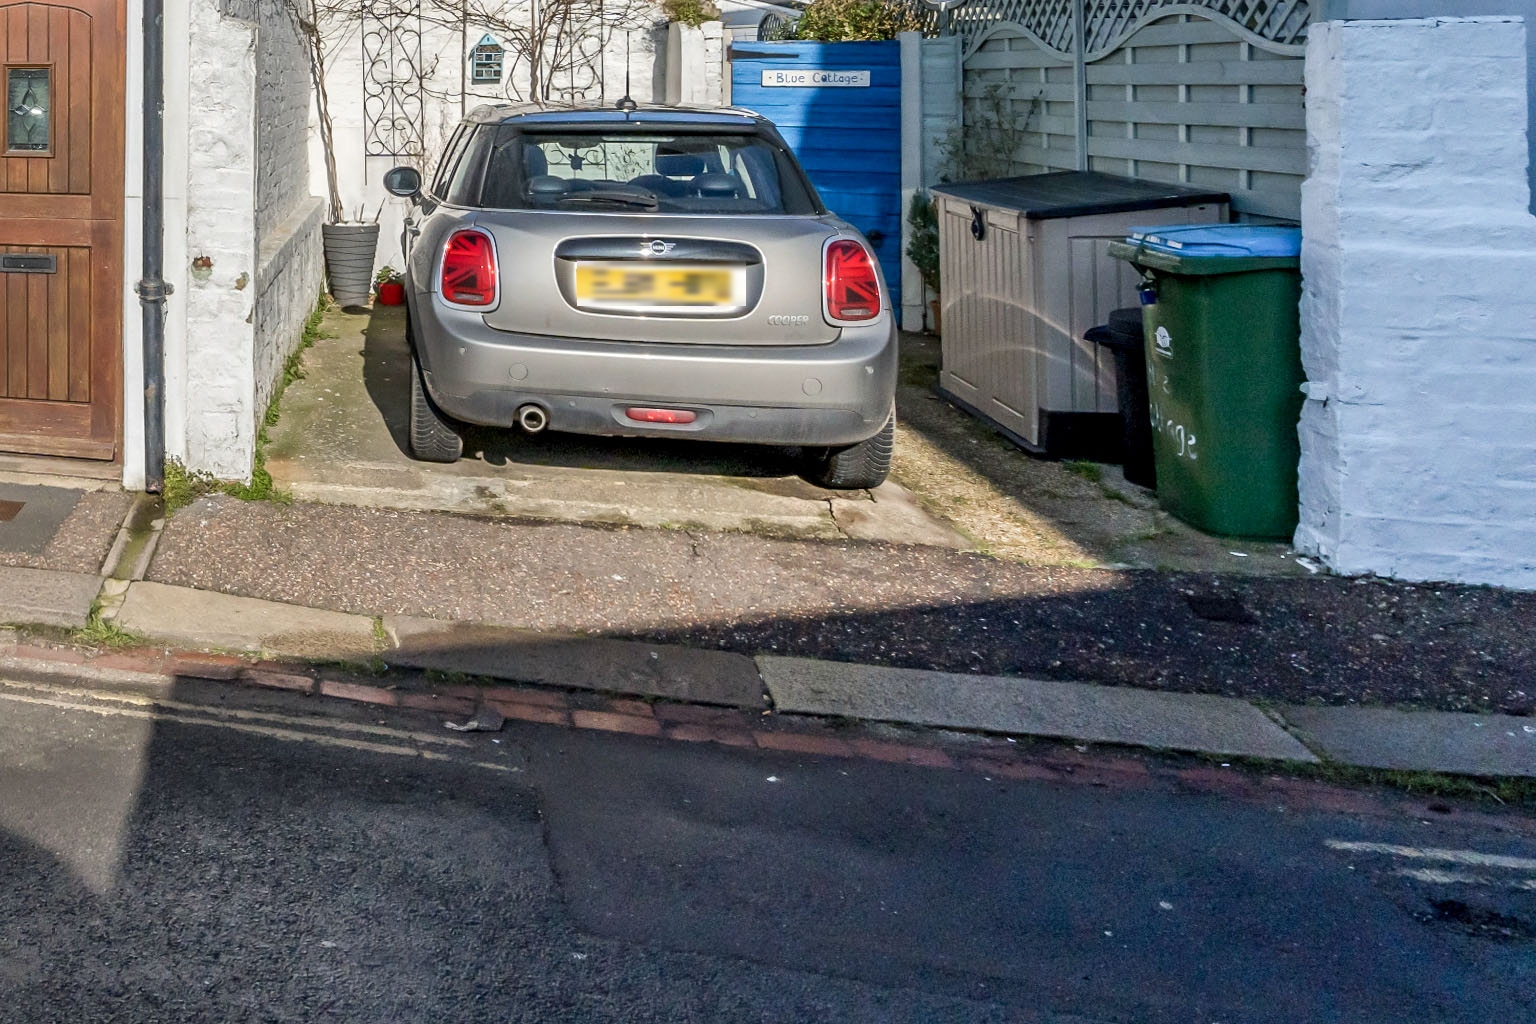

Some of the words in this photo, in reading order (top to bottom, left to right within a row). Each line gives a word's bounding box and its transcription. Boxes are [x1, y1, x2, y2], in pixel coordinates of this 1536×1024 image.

[776, 72, 805, 83] Blue
[812, 72, 859, 85] Cottage
[768, 315, 809, 326] COOPER
